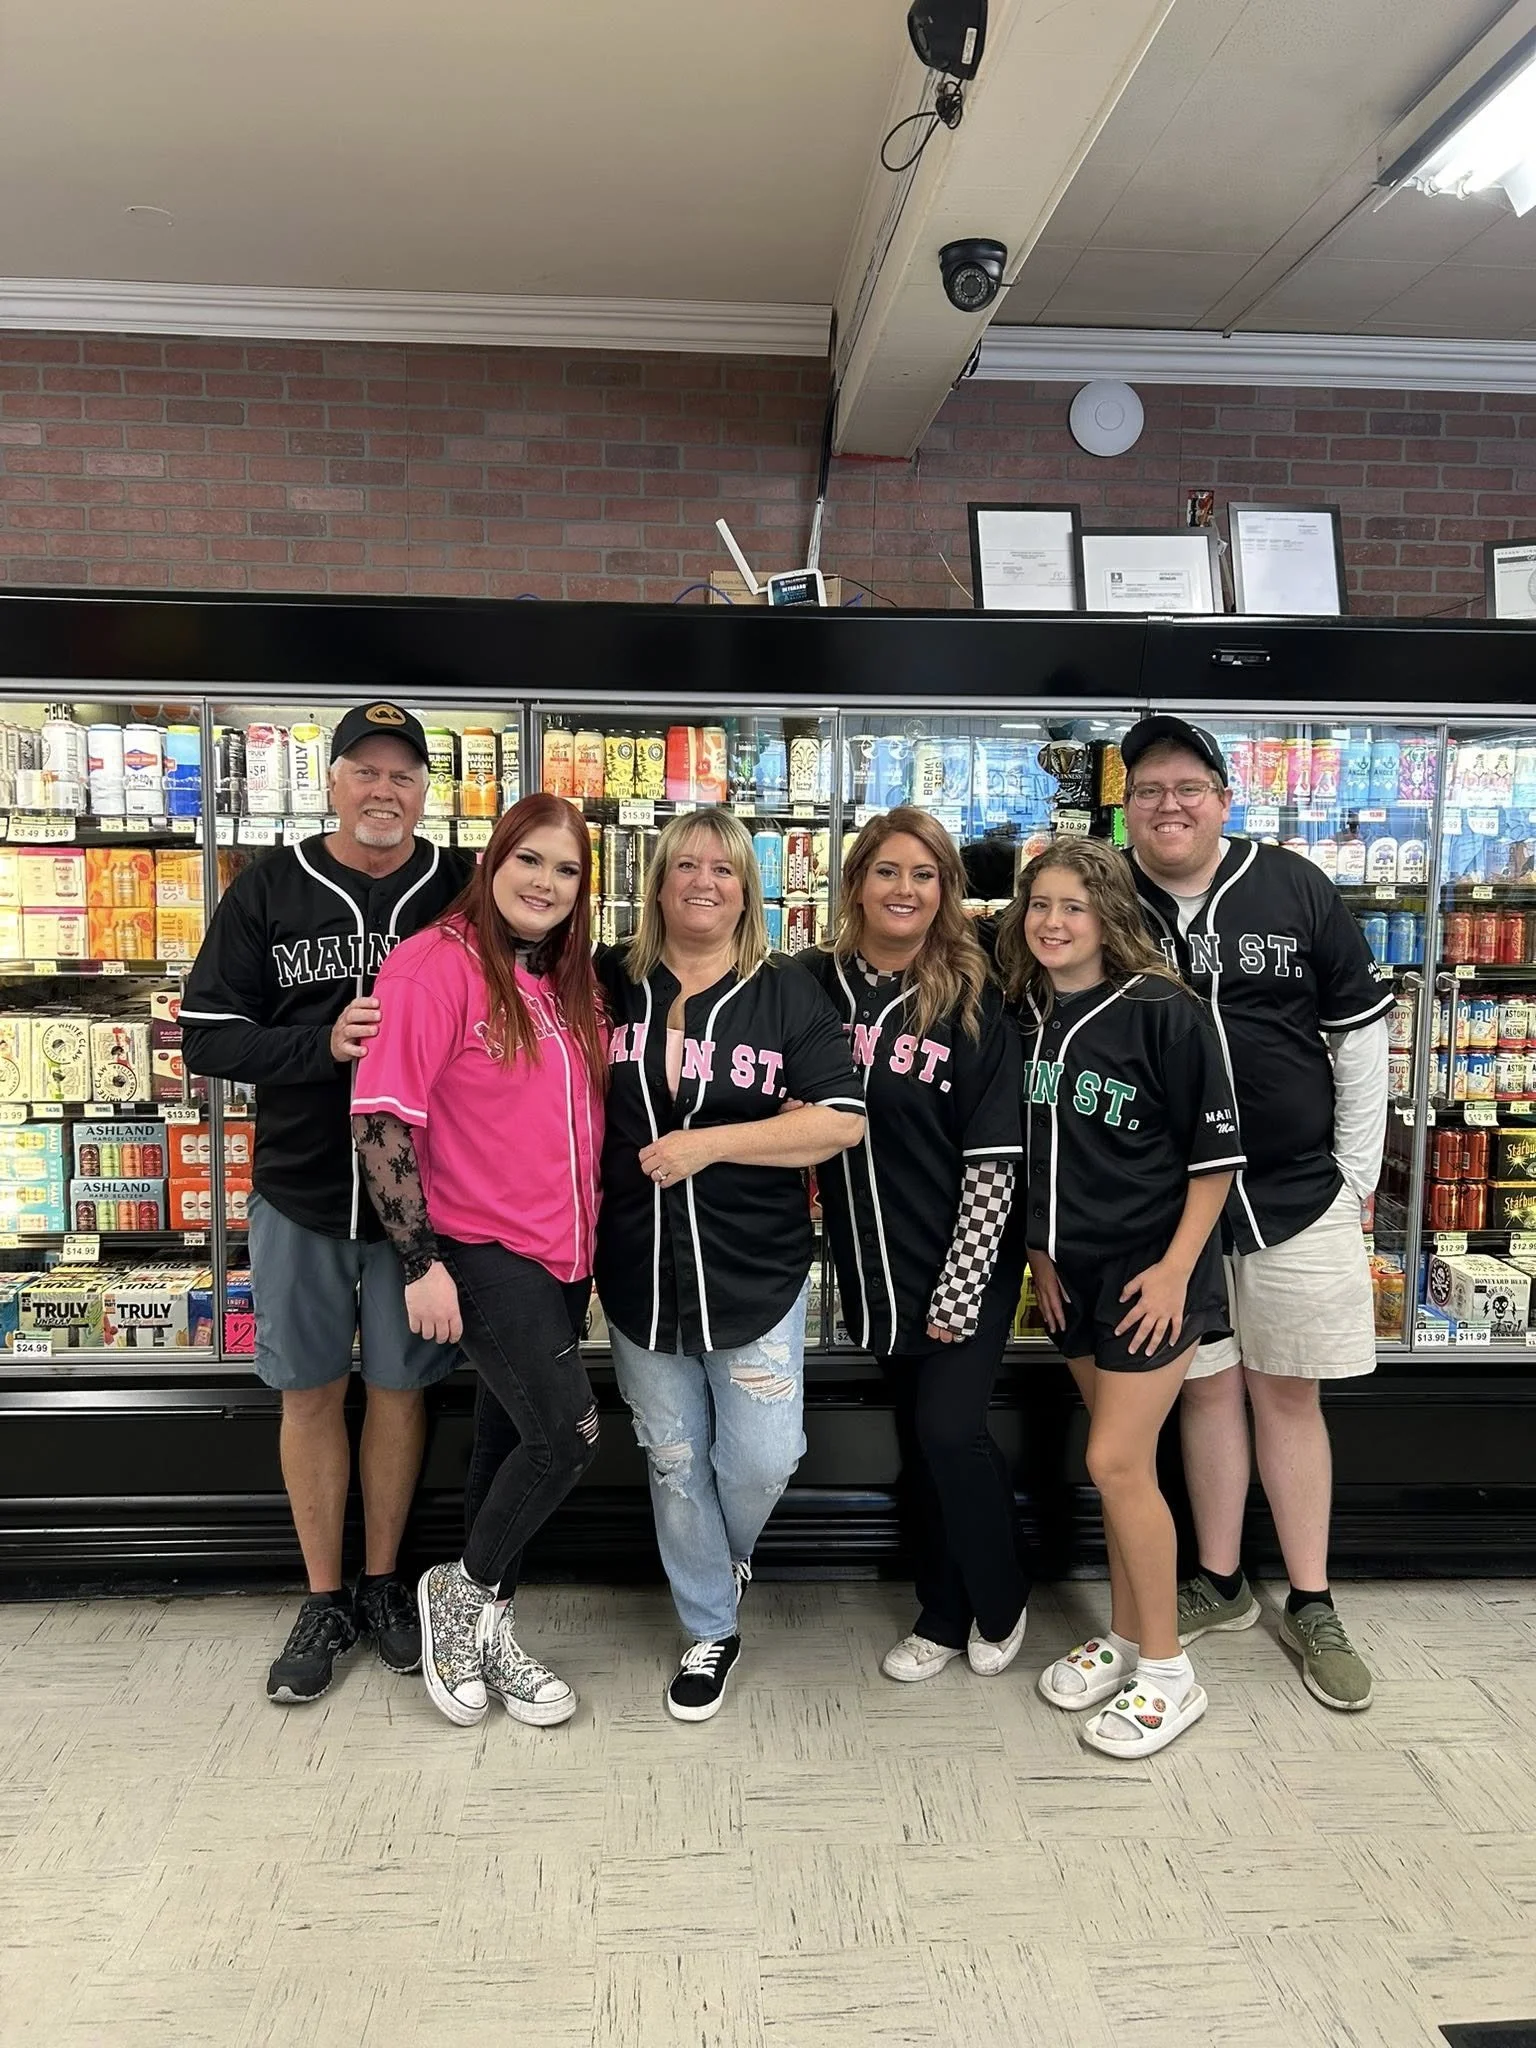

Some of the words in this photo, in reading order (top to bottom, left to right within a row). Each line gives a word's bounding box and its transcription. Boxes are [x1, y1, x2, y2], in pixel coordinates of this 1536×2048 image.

[296, 745, 309, 790] TRULY
[621, 810, 650, 820] $15.99
[1059, 821, 1087, 831] $10.99
[1248, 820, 1275, 828] $17.99
[44, 829, 69, 839] $3.49
[244, 830, 269, 839] $3.69
[463, 833, 487, 841] $3.49
[160, 853, 178, 901] SEATTLE
[160, 911, 178, 960] SEATTLE
[273, 933, 400, 988] MAIN
[1239, 933, 1303, 978] ST.
[57, 1022, 84, 1037] WHITE
[72, 1037, 87, 1062] CLAW
[889, 1033, 952, 1093] ST.
[730, 1043, 788, 1099] ST.
[94, 1065, 108, 1089] CLAW
[1073, 1069, 1139, 1131] ST.
[167, 1110, 196, 1119] $13.99
[1468, 1113, 1493, 1122] $12.99
[86, 1125, 155, 1136] ASHLAND
[82, 1182, 151, 1193] ASHLAND
[66, 1246, 96, 1256] $14.99
[1440, 1243, 1466, 1252] $12.99
[112, 1282, 168, 1290] TRULY
[32, 1302, 88, 1319] TRULY
[117, 1303, 172, 1319] TRULY
[1417, 1332, 1446, 1343] $13.99
[1460, 1333, 1487, 1342] $11.99
[16, 1341, 48, 1352] $24.99
